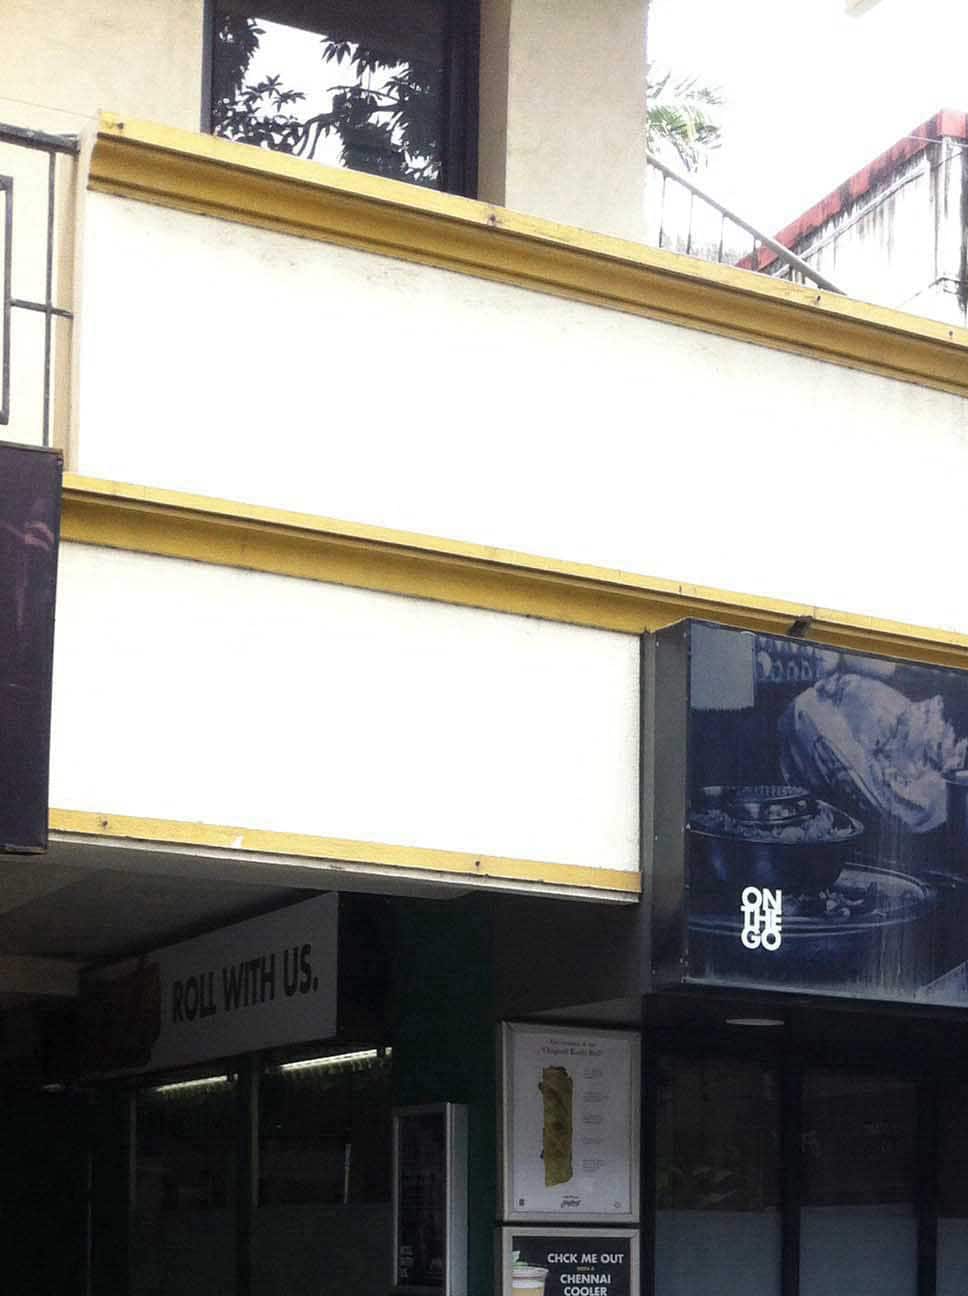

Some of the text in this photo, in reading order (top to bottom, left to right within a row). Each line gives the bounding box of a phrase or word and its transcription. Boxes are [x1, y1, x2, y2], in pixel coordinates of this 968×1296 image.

[742, 886, 782, 911] ON
[741, 928, 782, 951] GO
[171, 944, 319, 1024] ROLL WITH US.
[547, 1253, 624, 1264] CHCK ME OUT
[560, 1274, 611, 1285] CHENNAI
[563, 1286, 608, 1296] COOLER
